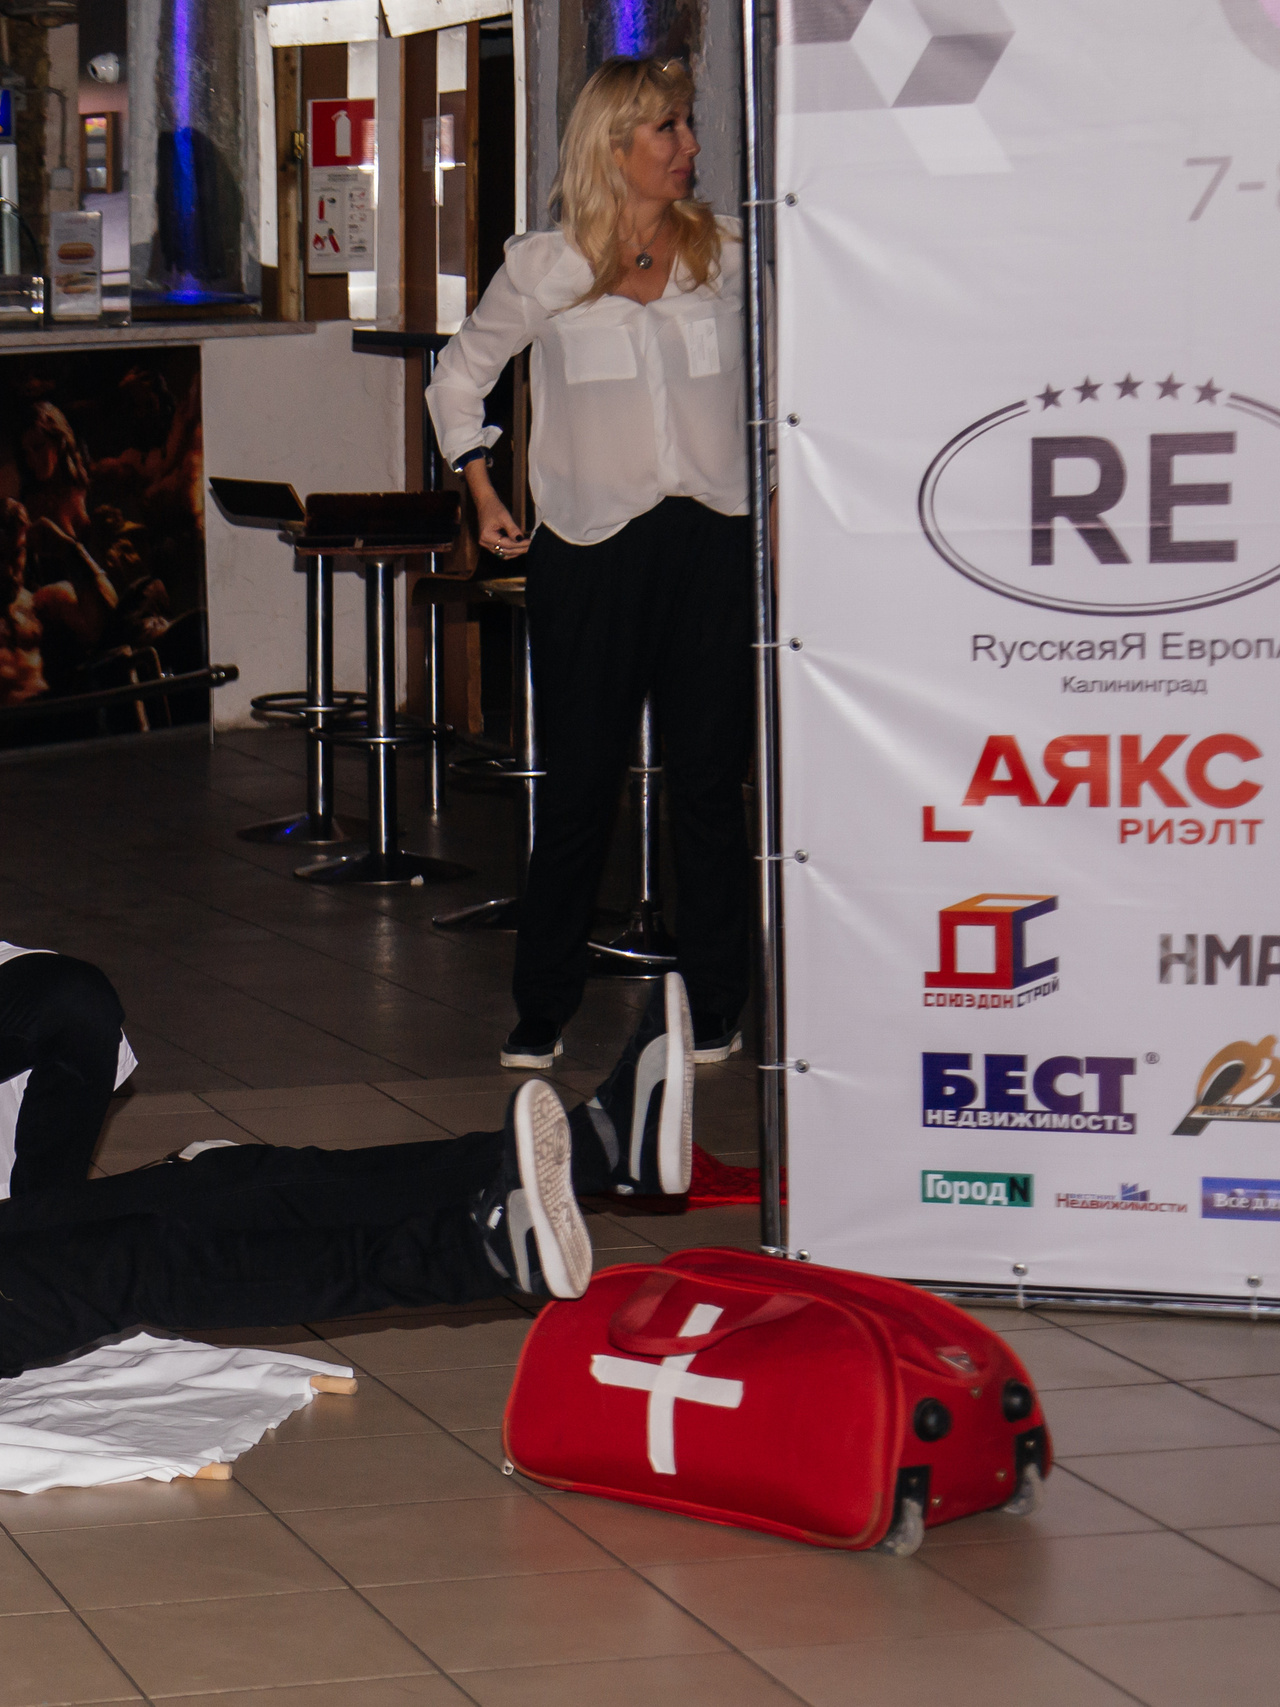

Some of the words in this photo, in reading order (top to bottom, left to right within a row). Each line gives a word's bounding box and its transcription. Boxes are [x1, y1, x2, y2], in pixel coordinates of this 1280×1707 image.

[1184, 155, 1280, 222] 7-
[1031, 432, 1237, 566] RE
[1161, 632, 1280, 666] Европ
[1062, 675, 1208, 695] Калининград
[961, 733, 1264, 809] АЯКС
[1118, 818, 1264, 845] РИЭЛТ
[922, 1051, 1136, 1116] БЕСТ
[926, 1109, 1133, 1131] НЕДВИЖИМОСТЬ
